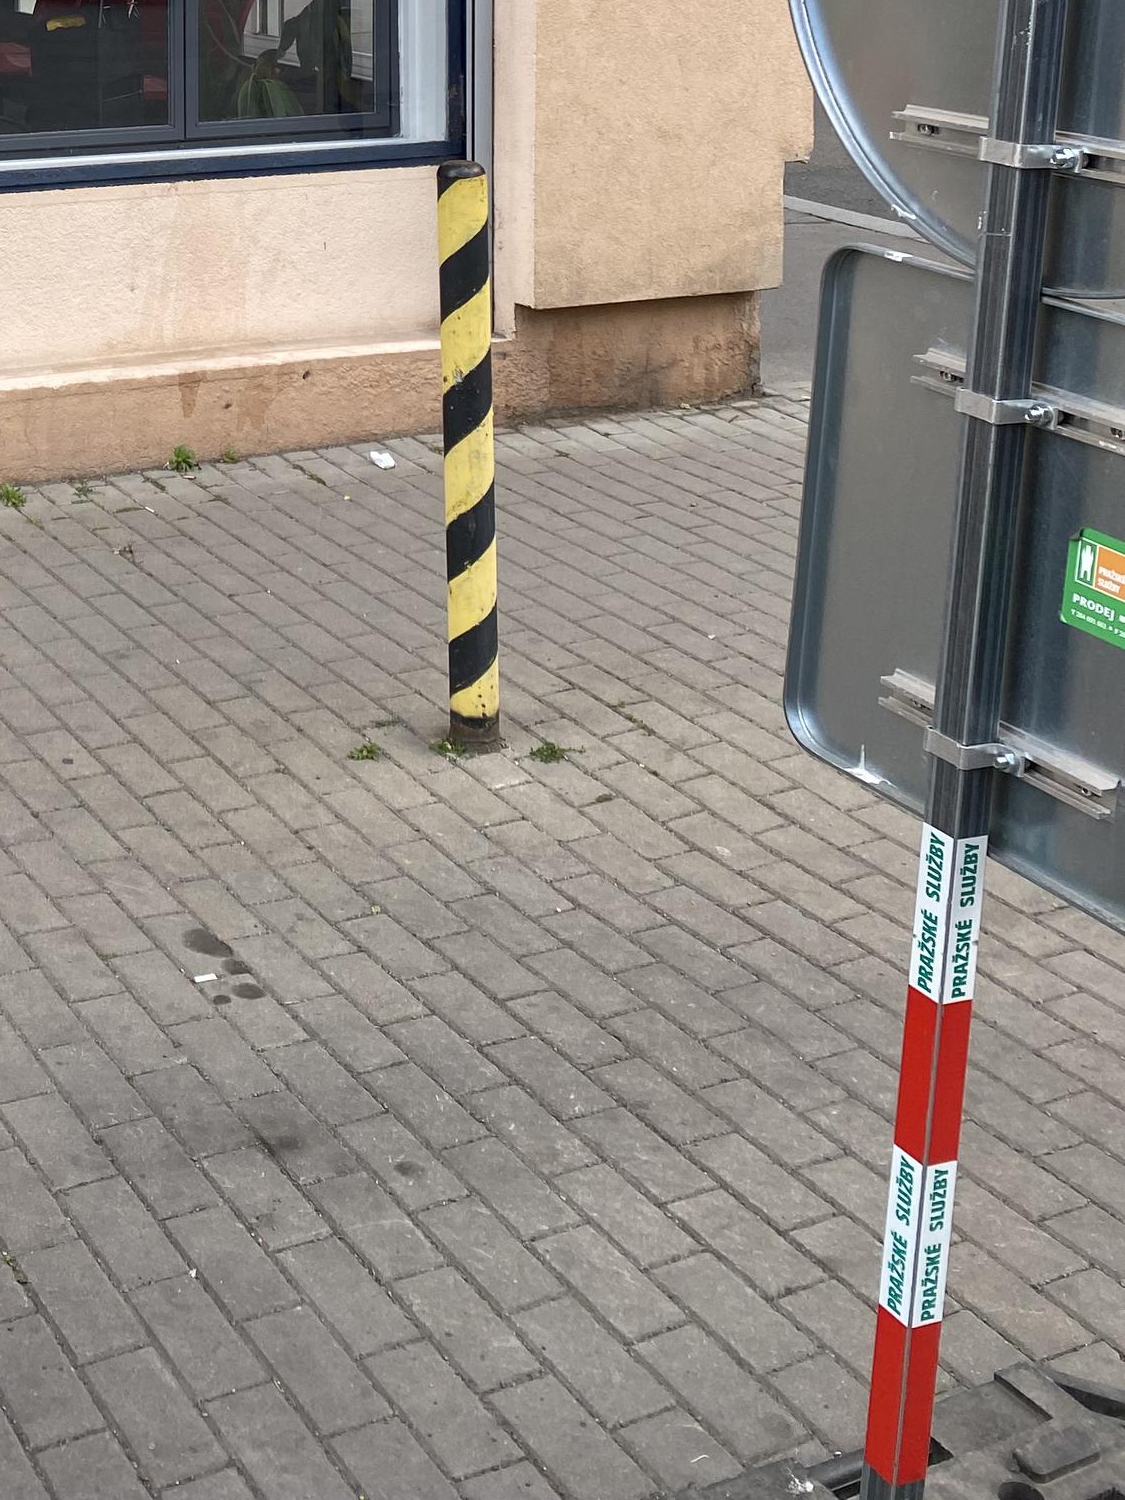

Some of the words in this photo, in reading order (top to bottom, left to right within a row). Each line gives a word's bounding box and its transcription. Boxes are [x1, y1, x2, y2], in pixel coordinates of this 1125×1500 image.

[1073, 593, 1115, 622] PRODEJ
[925, 831, 945, 902] SLUŽBY
[960, 843, 979, 908] SLUŽBY
[917, 909, 939, 993] PRAŽSKÉ
[951, 918, 973, 999] PRAŽSKÉ
[896, 1157, 916, 1226] SLUŽBY
[929, 1168, 949, 1232] SLUŽBY
[887, 1232, 909, 1317] PRAŽSKÉ
[920, 1242, 942, 1322] PRAŽSKÉ
